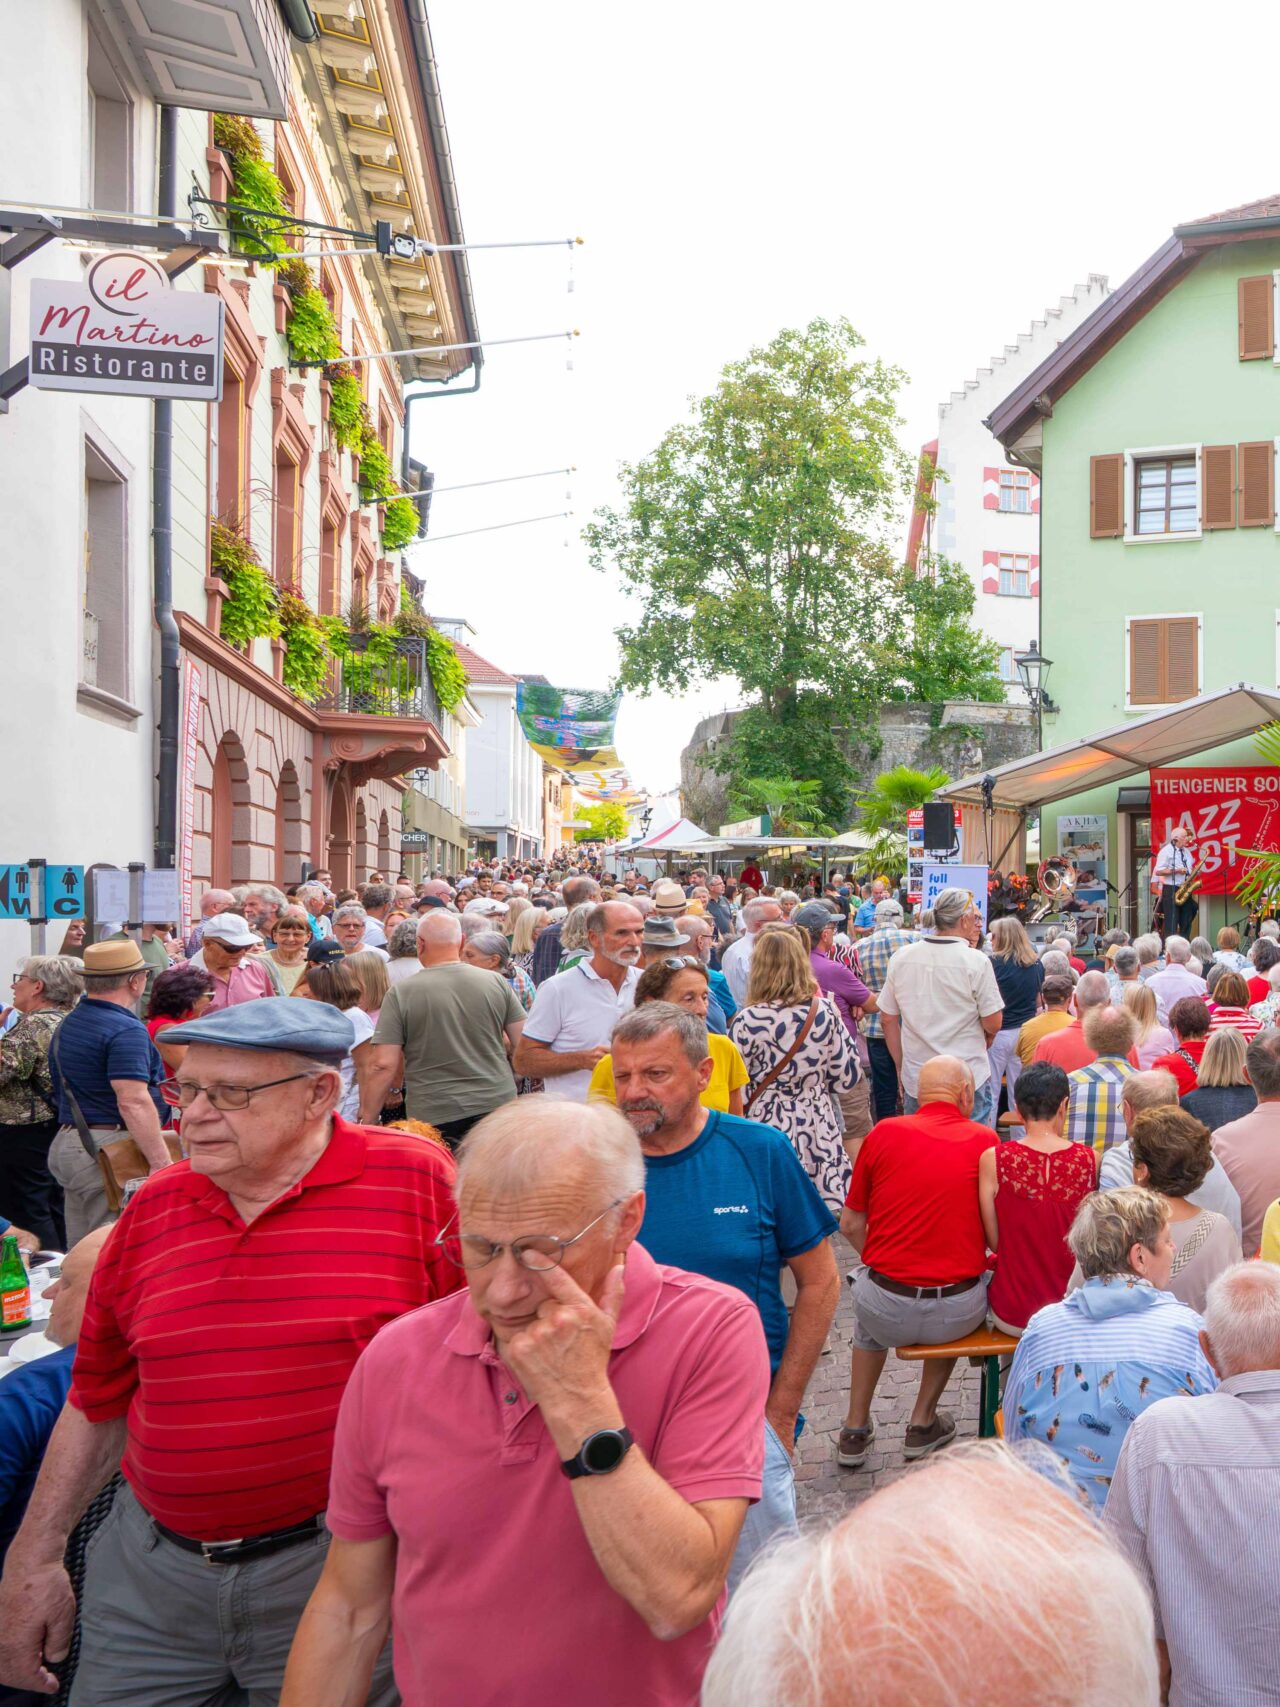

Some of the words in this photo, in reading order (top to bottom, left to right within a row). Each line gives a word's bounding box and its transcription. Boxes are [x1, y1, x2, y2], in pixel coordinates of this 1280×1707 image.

[105, 268, 148, 301] il
[39, 305, 214, 348] Martino
[39, 347, 207, 382] Ristorante
[1154, 777, 1248, 795] TIENGENER
[713, 1206, 741, 1216] sports
